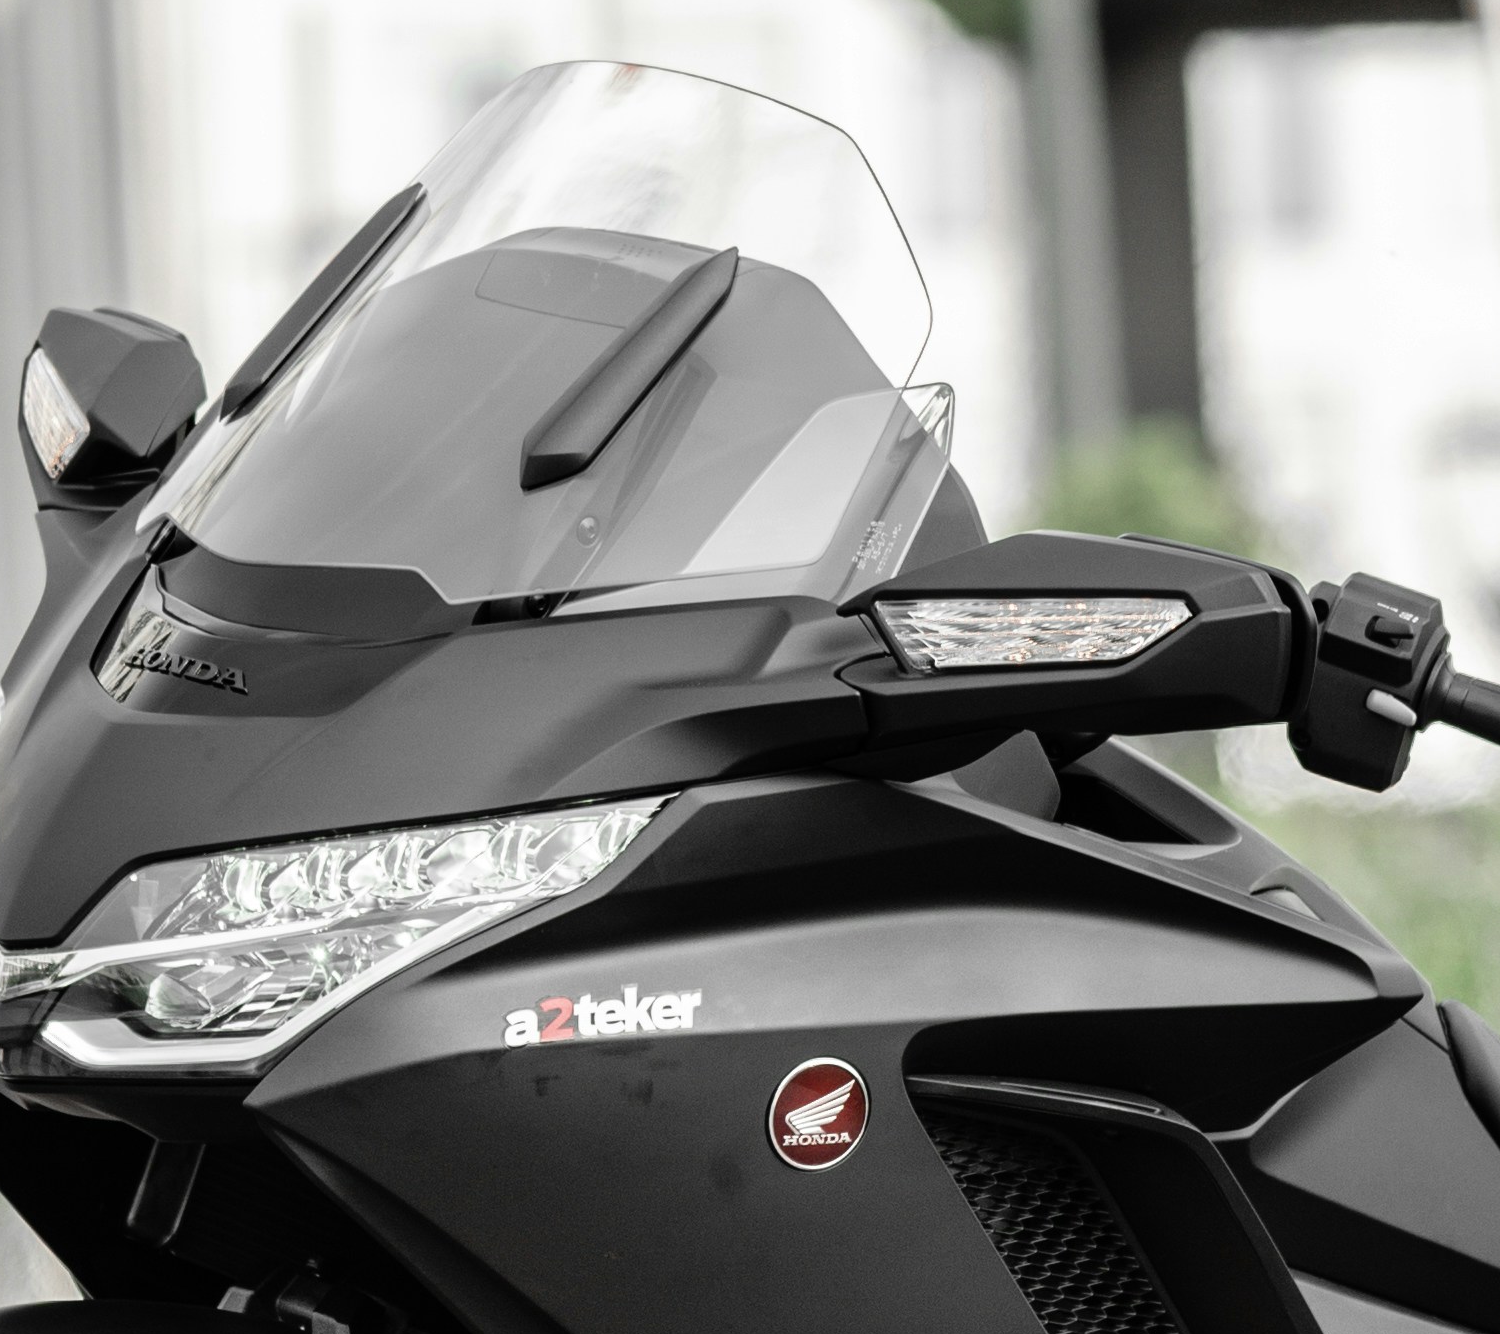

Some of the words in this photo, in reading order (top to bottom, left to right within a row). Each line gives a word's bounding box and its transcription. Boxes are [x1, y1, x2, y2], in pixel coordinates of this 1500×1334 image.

[124, 648, 248, 696] HONDA
[504, 984, 702, 1048] a2teker
[782, 1131, 853, 1148] HONDA
